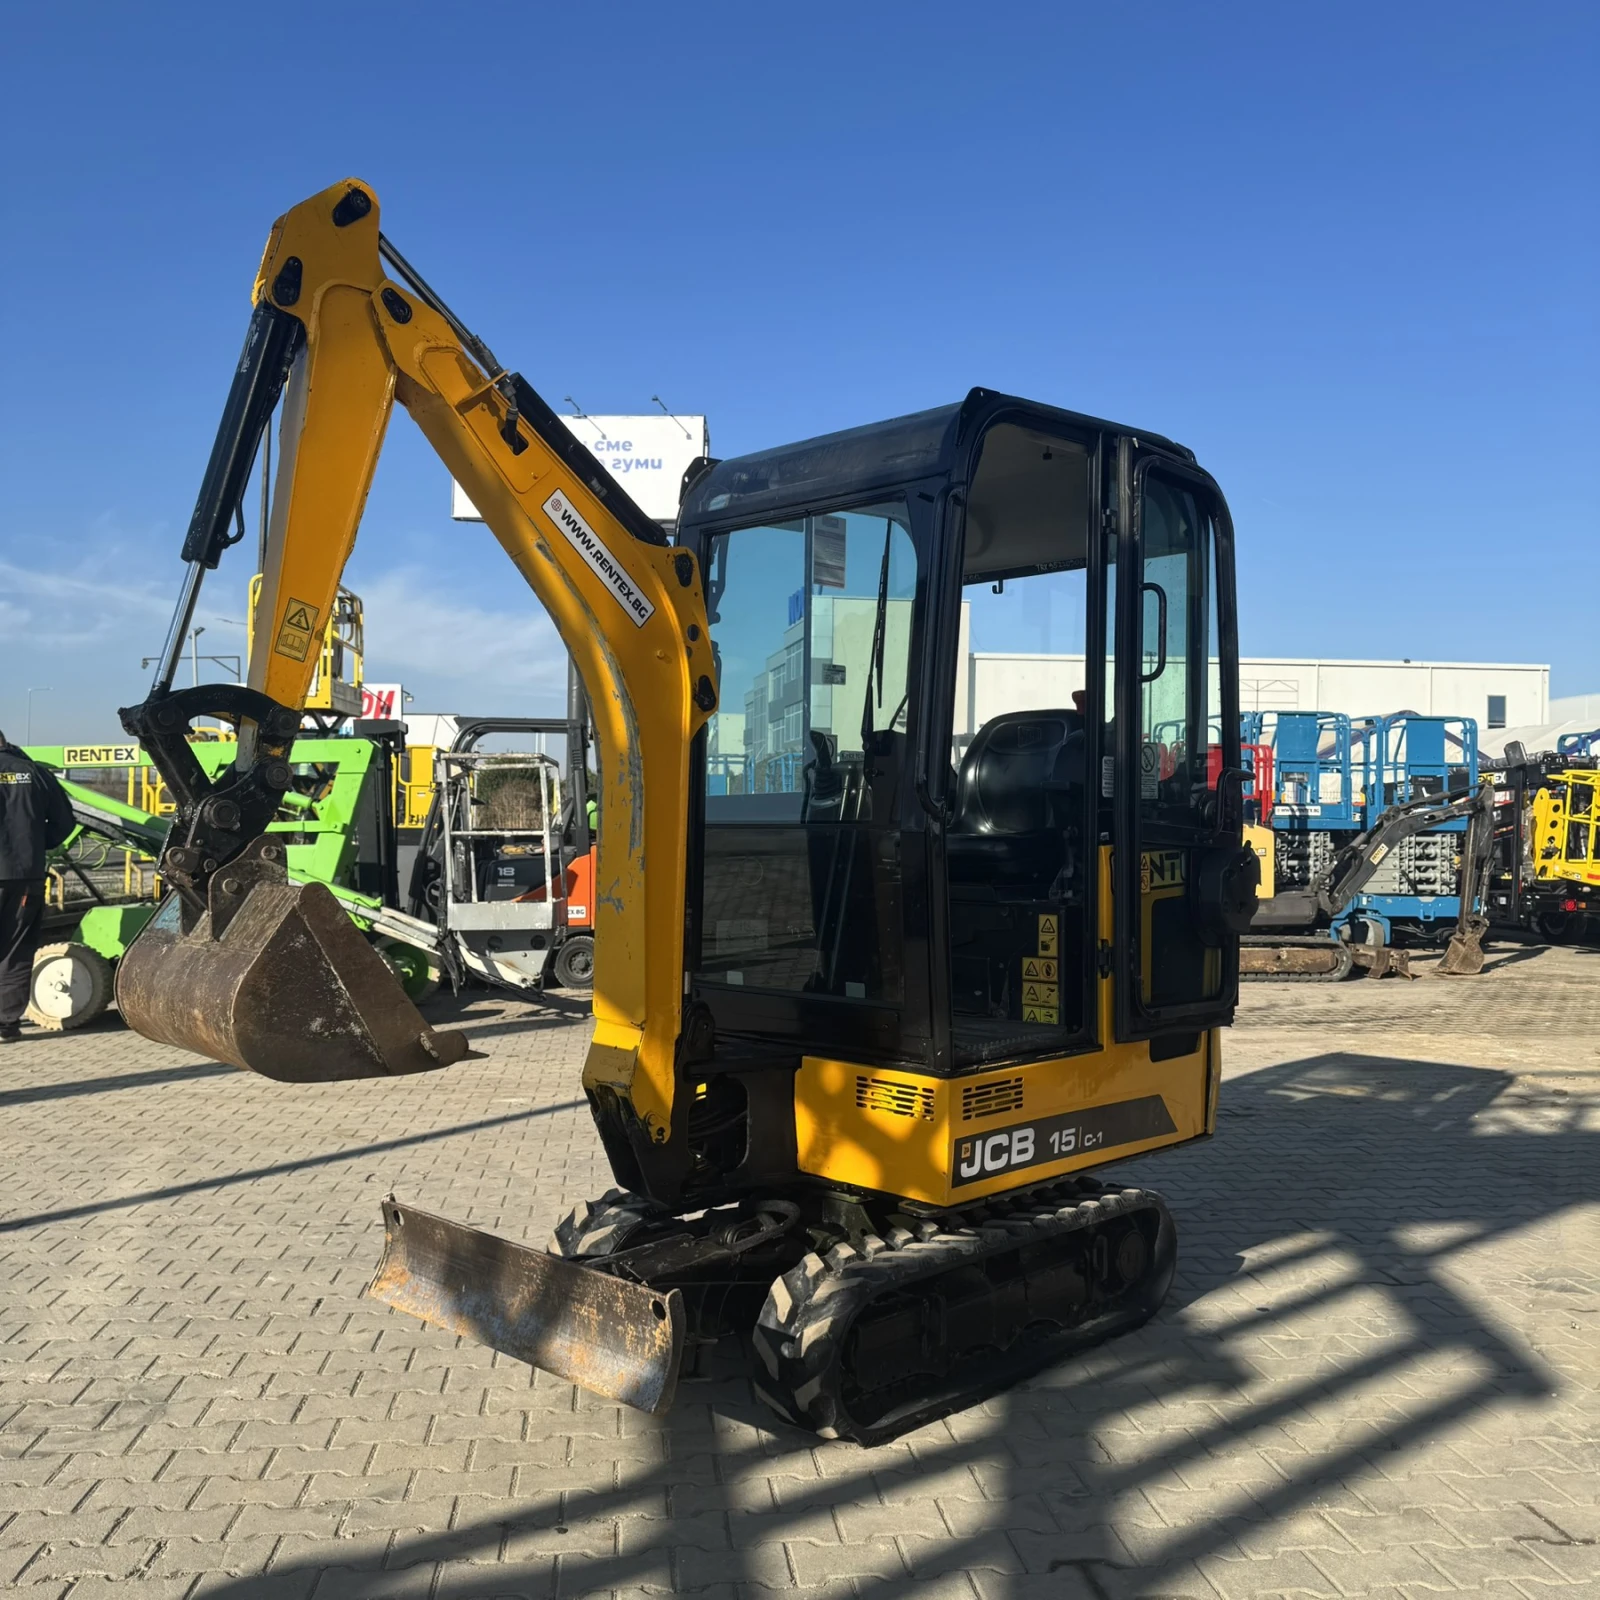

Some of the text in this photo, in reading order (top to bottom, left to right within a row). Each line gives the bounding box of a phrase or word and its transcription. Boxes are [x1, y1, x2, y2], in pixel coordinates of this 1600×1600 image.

[594, 440, 633, 452] сме
[561, 509, 648, 619] WWW.RENTEX.BG
[67, 748, 135, 762] RENTEX
[0, 772, 31, 781] NTEX
[497, 867, 515, 876] 18
[961, 1128, 1103, 1178] JCB 15 C-1
